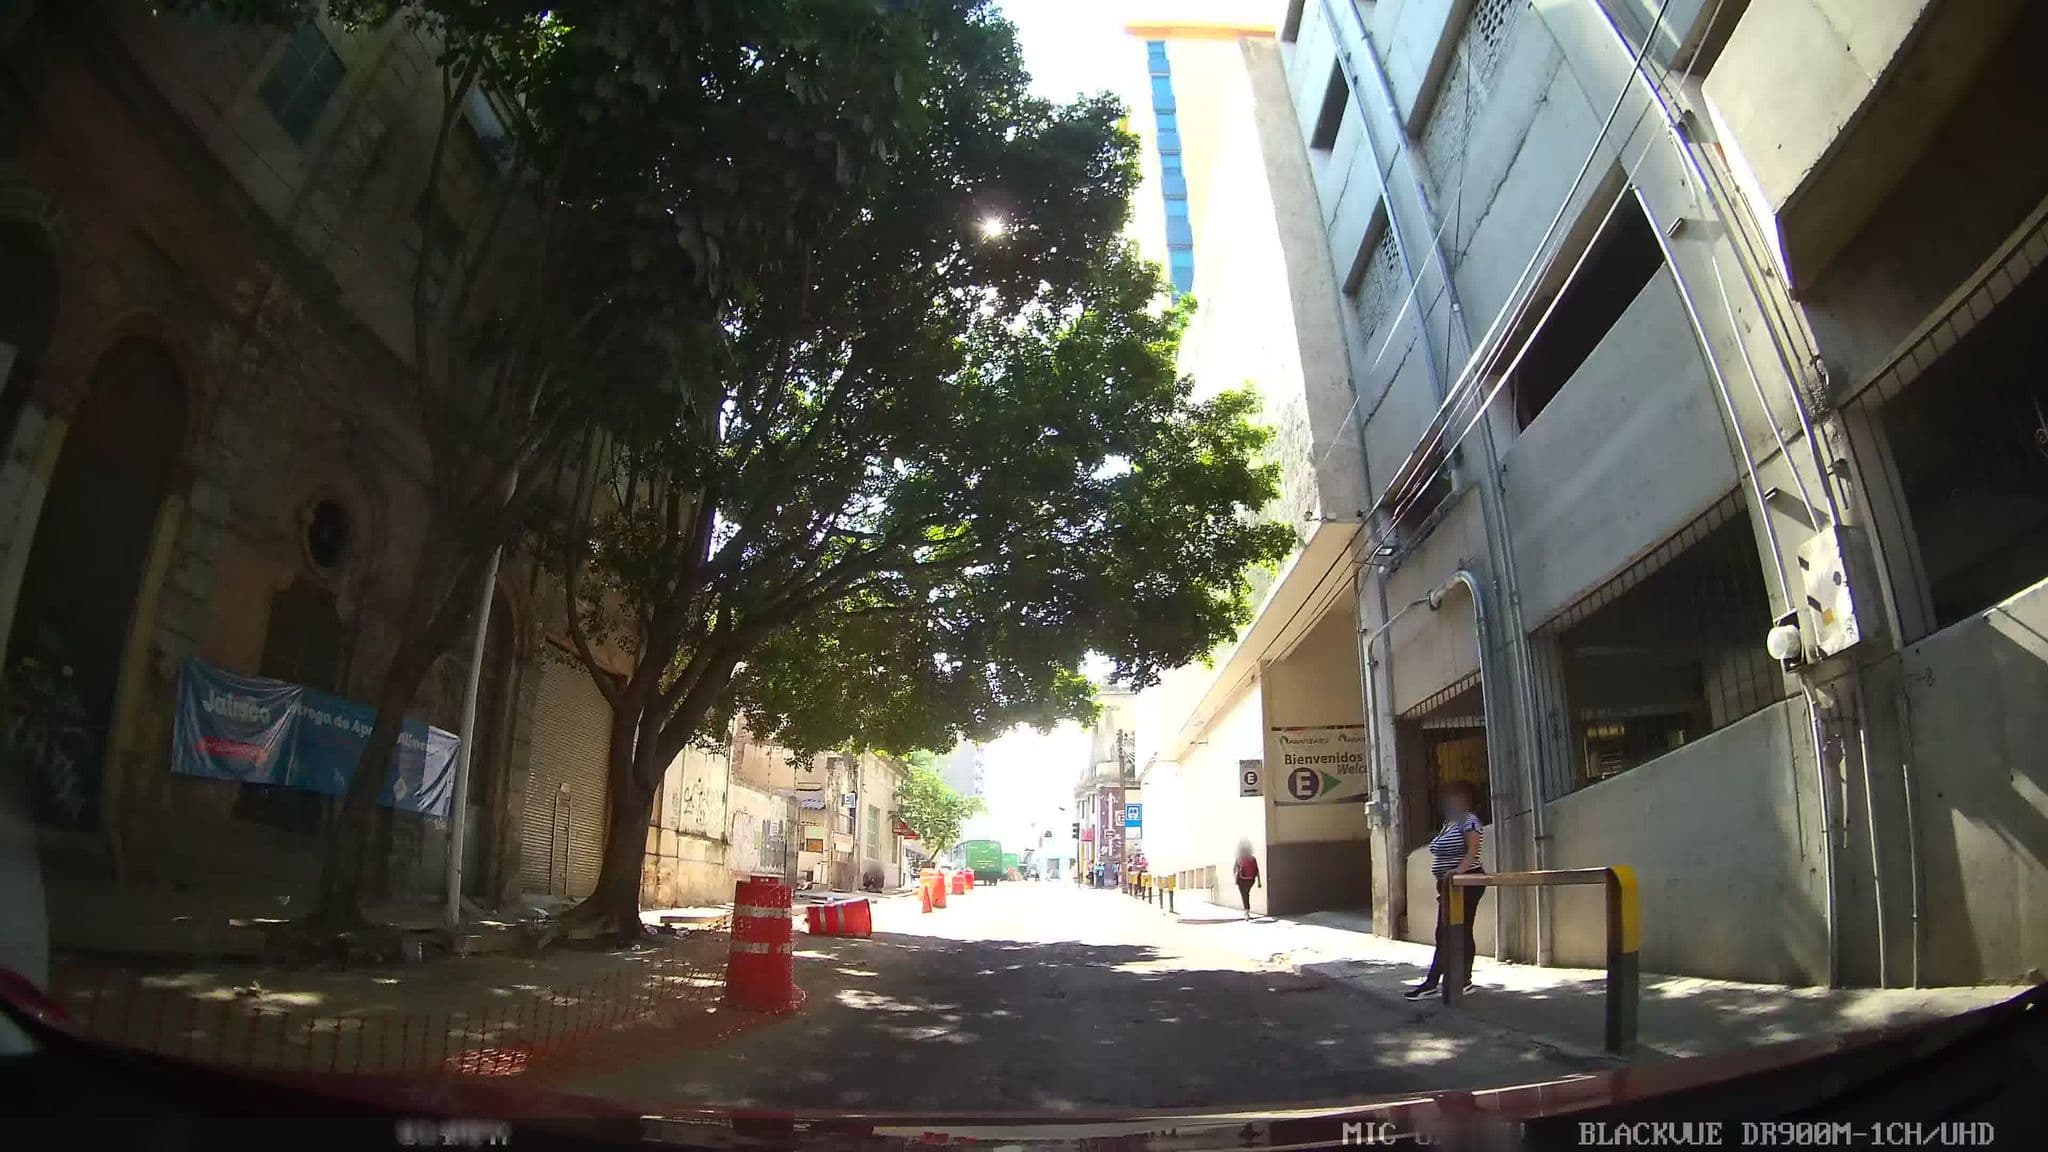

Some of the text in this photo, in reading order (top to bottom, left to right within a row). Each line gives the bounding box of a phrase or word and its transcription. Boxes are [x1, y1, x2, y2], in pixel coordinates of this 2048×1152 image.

[200, 688, 271, 724] Jalisco
[1285, 752, 1363, 765] Bienvenidos
[1295, 771, 1311, 796] E
